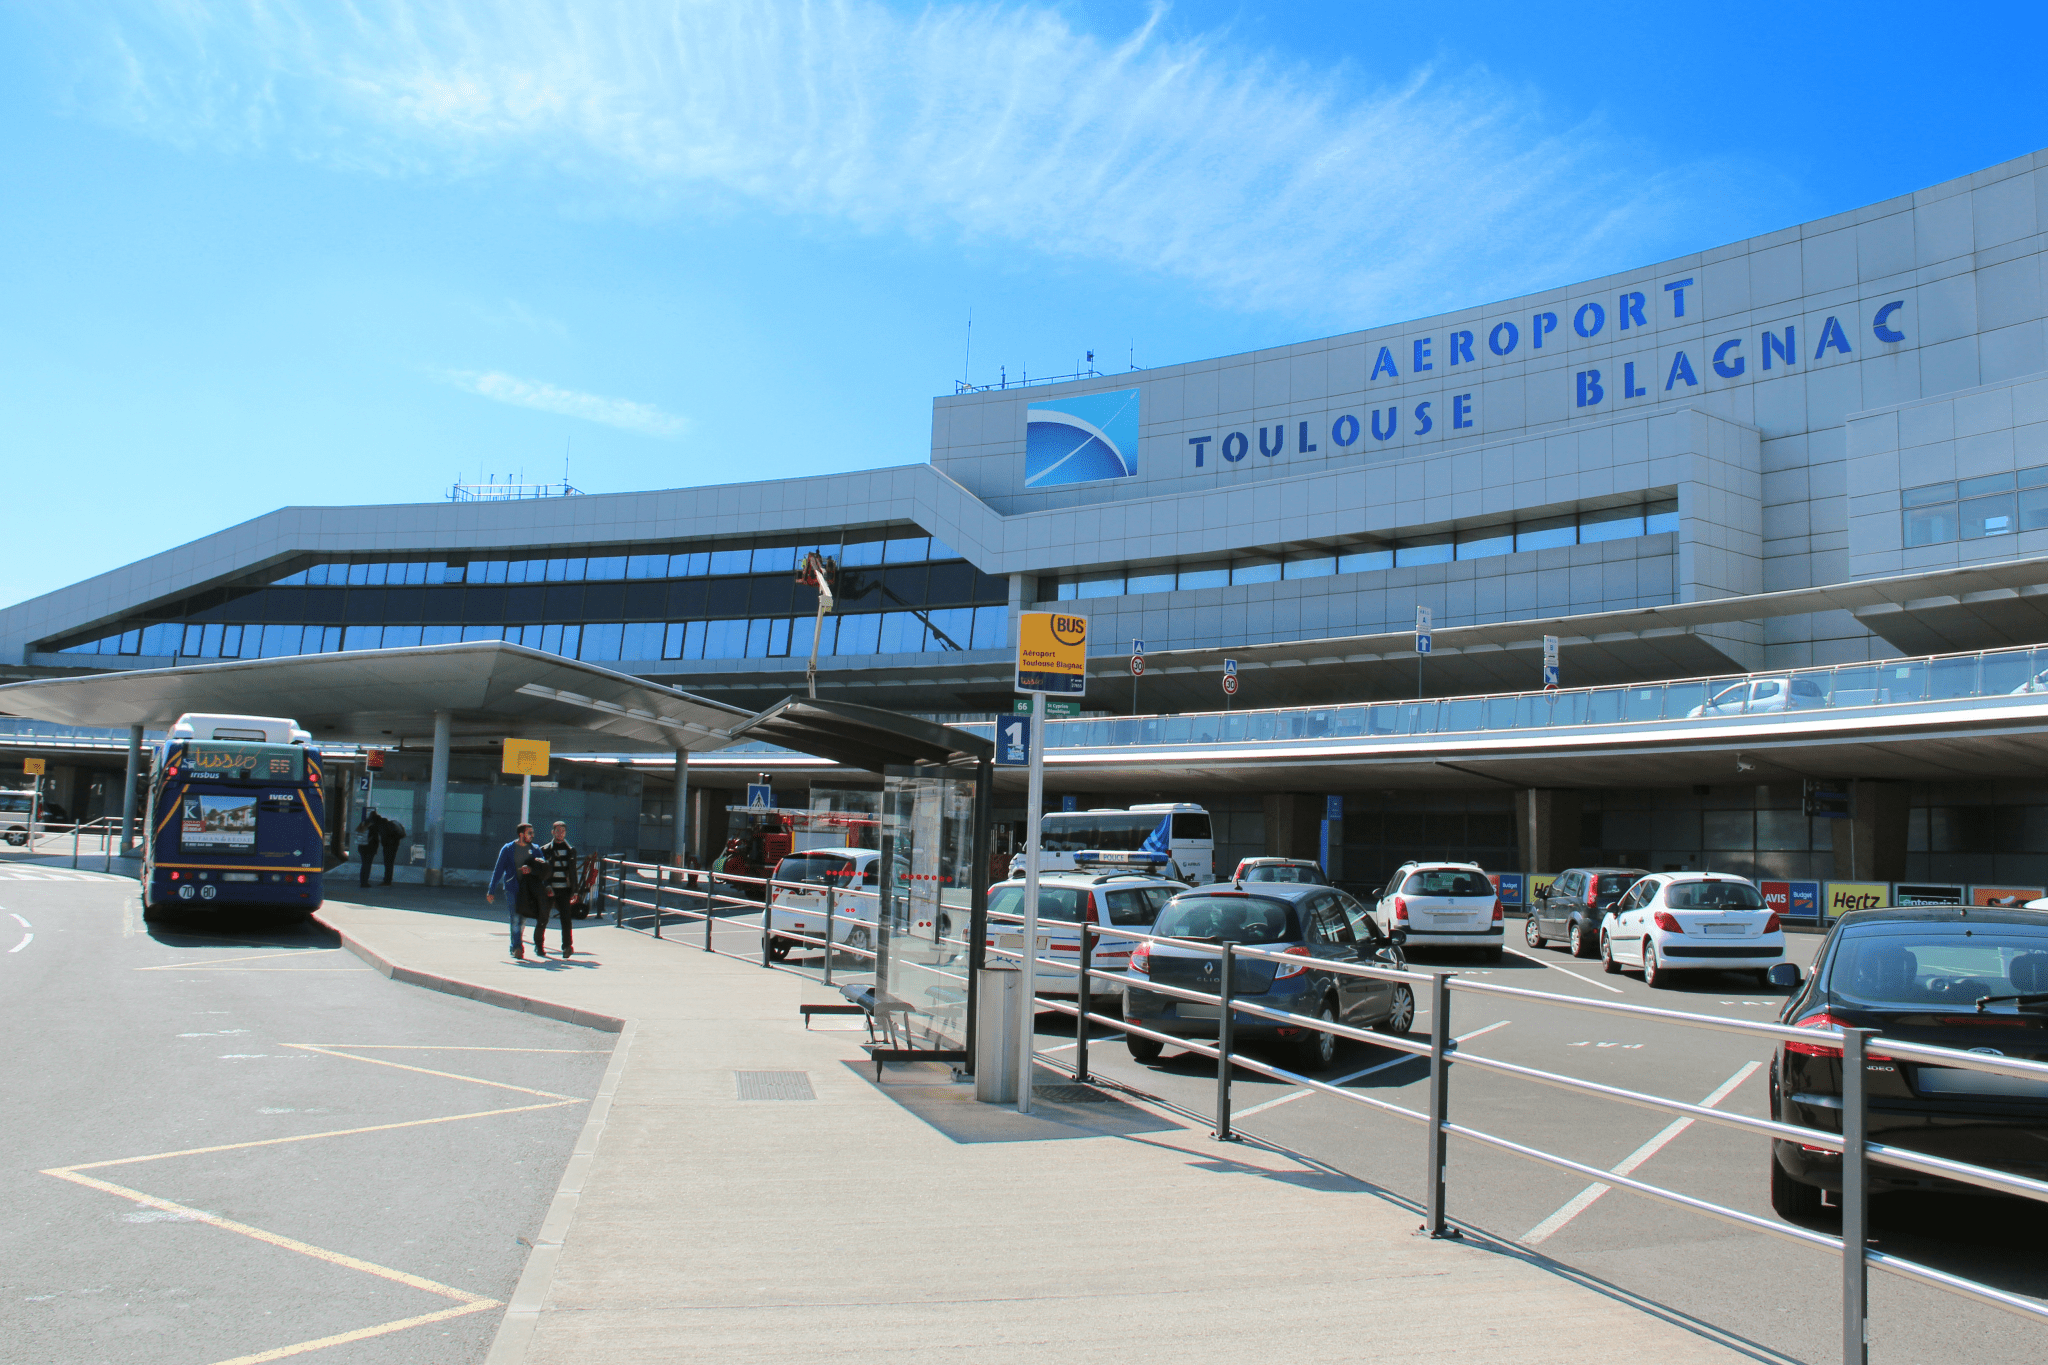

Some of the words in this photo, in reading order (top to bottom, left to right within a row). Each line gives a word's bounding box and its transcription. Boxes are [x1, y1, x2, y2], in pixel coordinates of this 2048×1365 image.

[1370, 277, 1694, 381] AEROPORT
[1188, 393, 1474, 468] TOULOUSE
[1576, 300, 1906, 408] BLAGNAC
[1057, 617, 1084, 634] BUS
[1022, 649, 1056, 658] Aéroport
[1022, 659, 1055, 668] Toulouse
[1056, 660, 1083, 670] Blagnac
[1134, 661, 1143, 671] 30
[1226, 680, 1235, 689] 30
[1017, 702, 1028, 710] 66
[1005, 722, 1023, 746] 1
[361, 778, 369, 789] 2
[183, 805, 198, 819] K
[1103, 853, 1125, 861] POLICE
[182, 886, 193, 898] 70
[203, 886, 214, 898] 80
[1793, 891, 1813, 899] Budget
[1765, 893, 1787, 903] AVIS
[1833, 892, 1881, 909] Hertz
